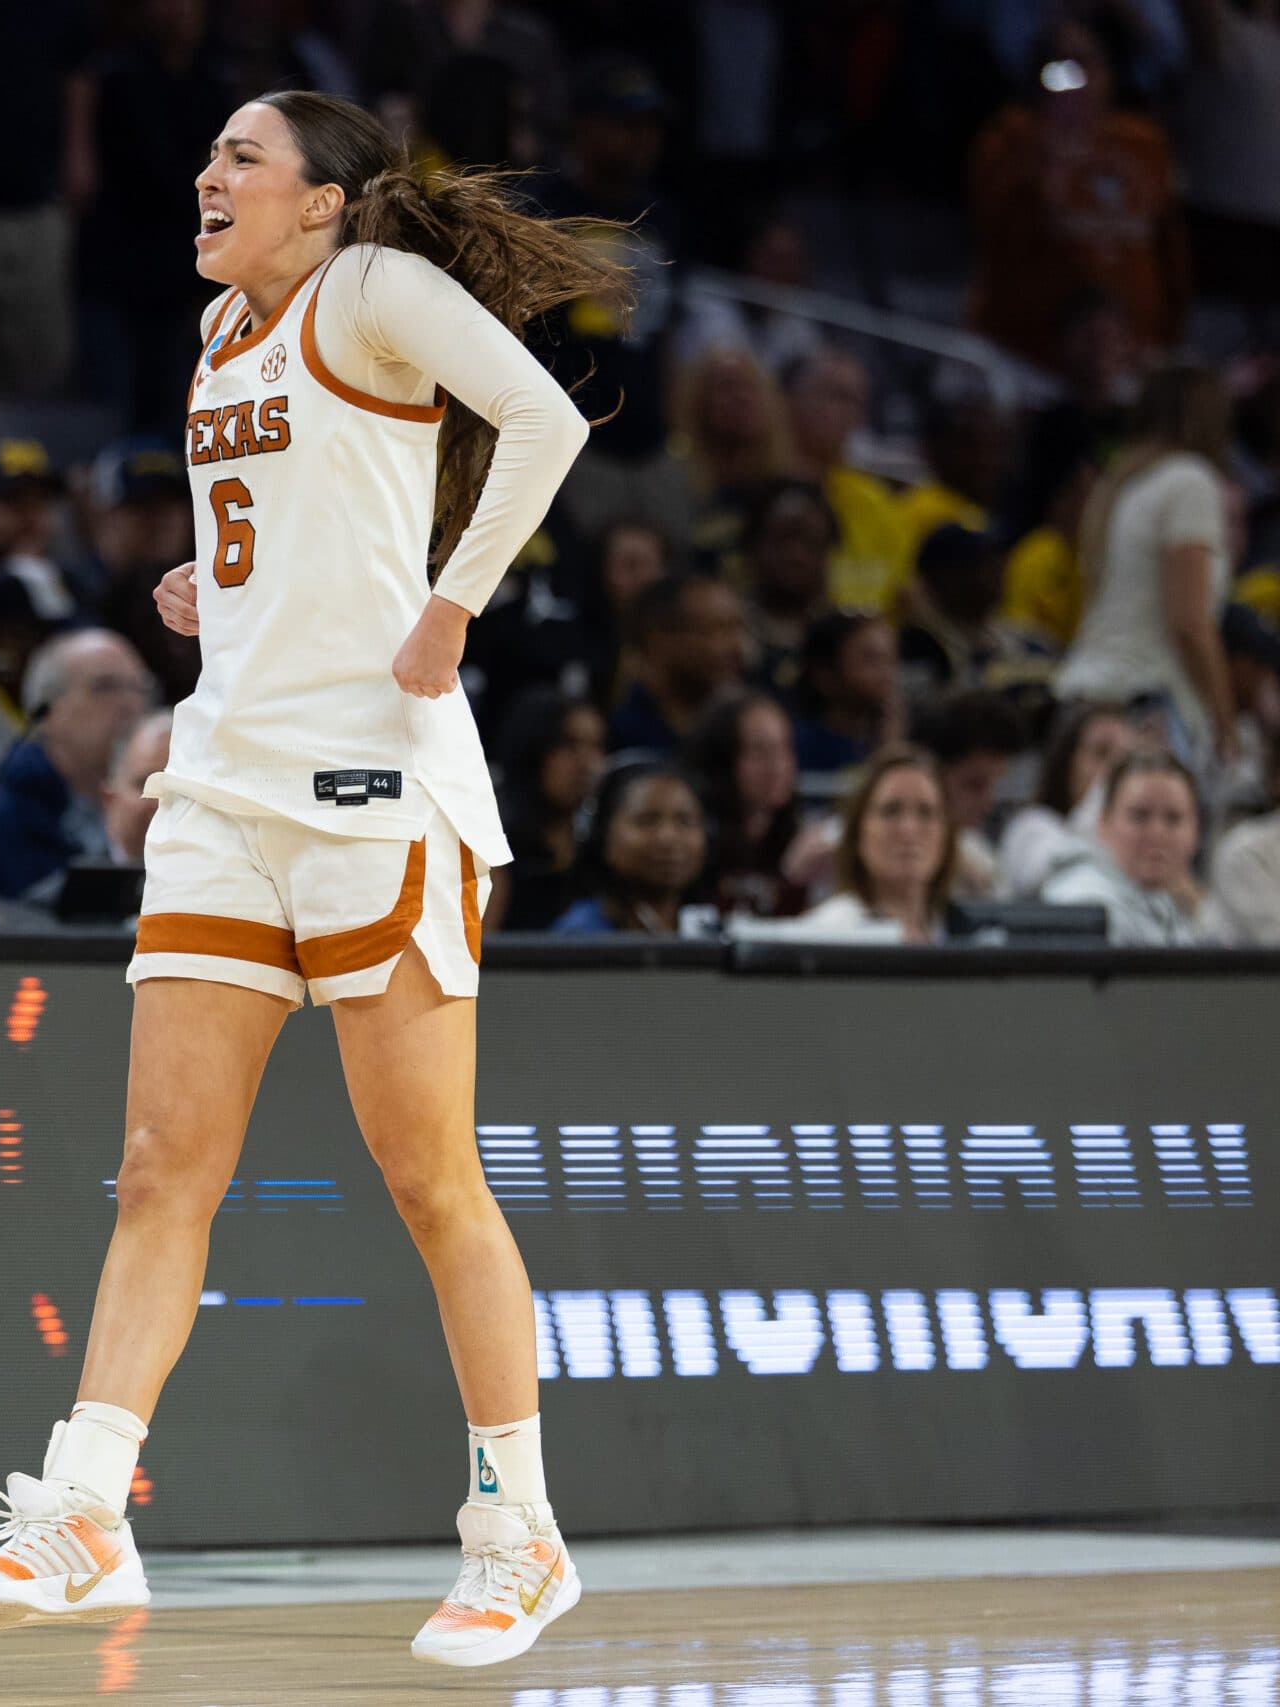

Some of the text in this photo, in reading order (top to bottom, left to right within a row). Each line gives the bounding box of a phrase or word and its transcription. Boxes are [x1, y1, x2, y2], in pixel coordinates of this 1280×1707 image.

[261, 343, 287, 382] SEC
[209, 477, 256, 589] 6
[372, 777, 389, 790] 44
